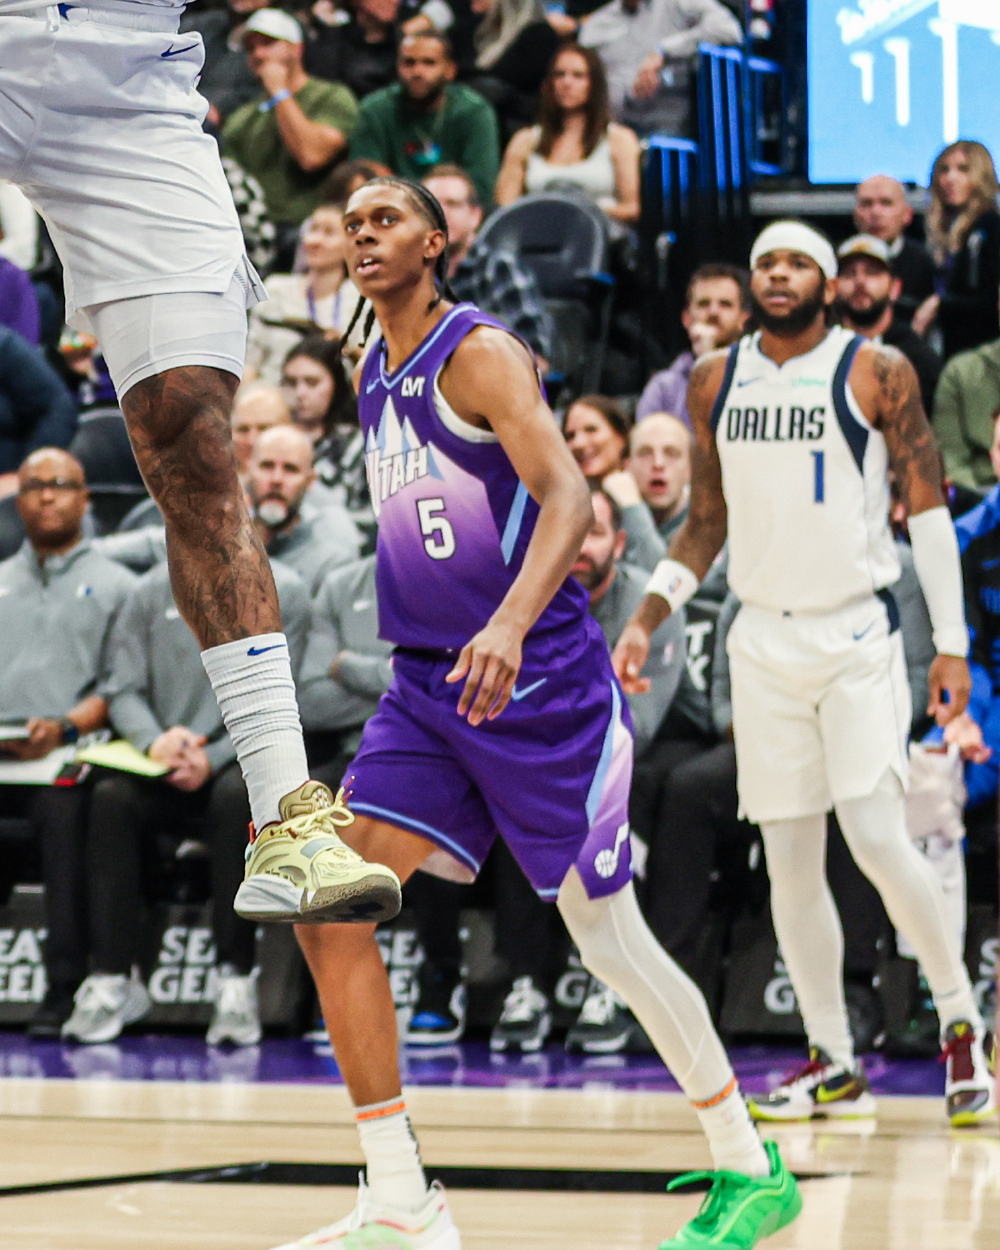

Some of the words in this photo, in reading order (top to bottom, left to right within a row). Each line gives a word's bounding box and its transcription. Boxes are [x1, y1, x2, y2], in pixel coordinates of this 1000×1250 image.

[726, 406, 826, 442] DALLAS
[365, 446, 429, 518] UTAH
[810, 449, 825, 504] 1
[415, 496, 456, 561] 5
